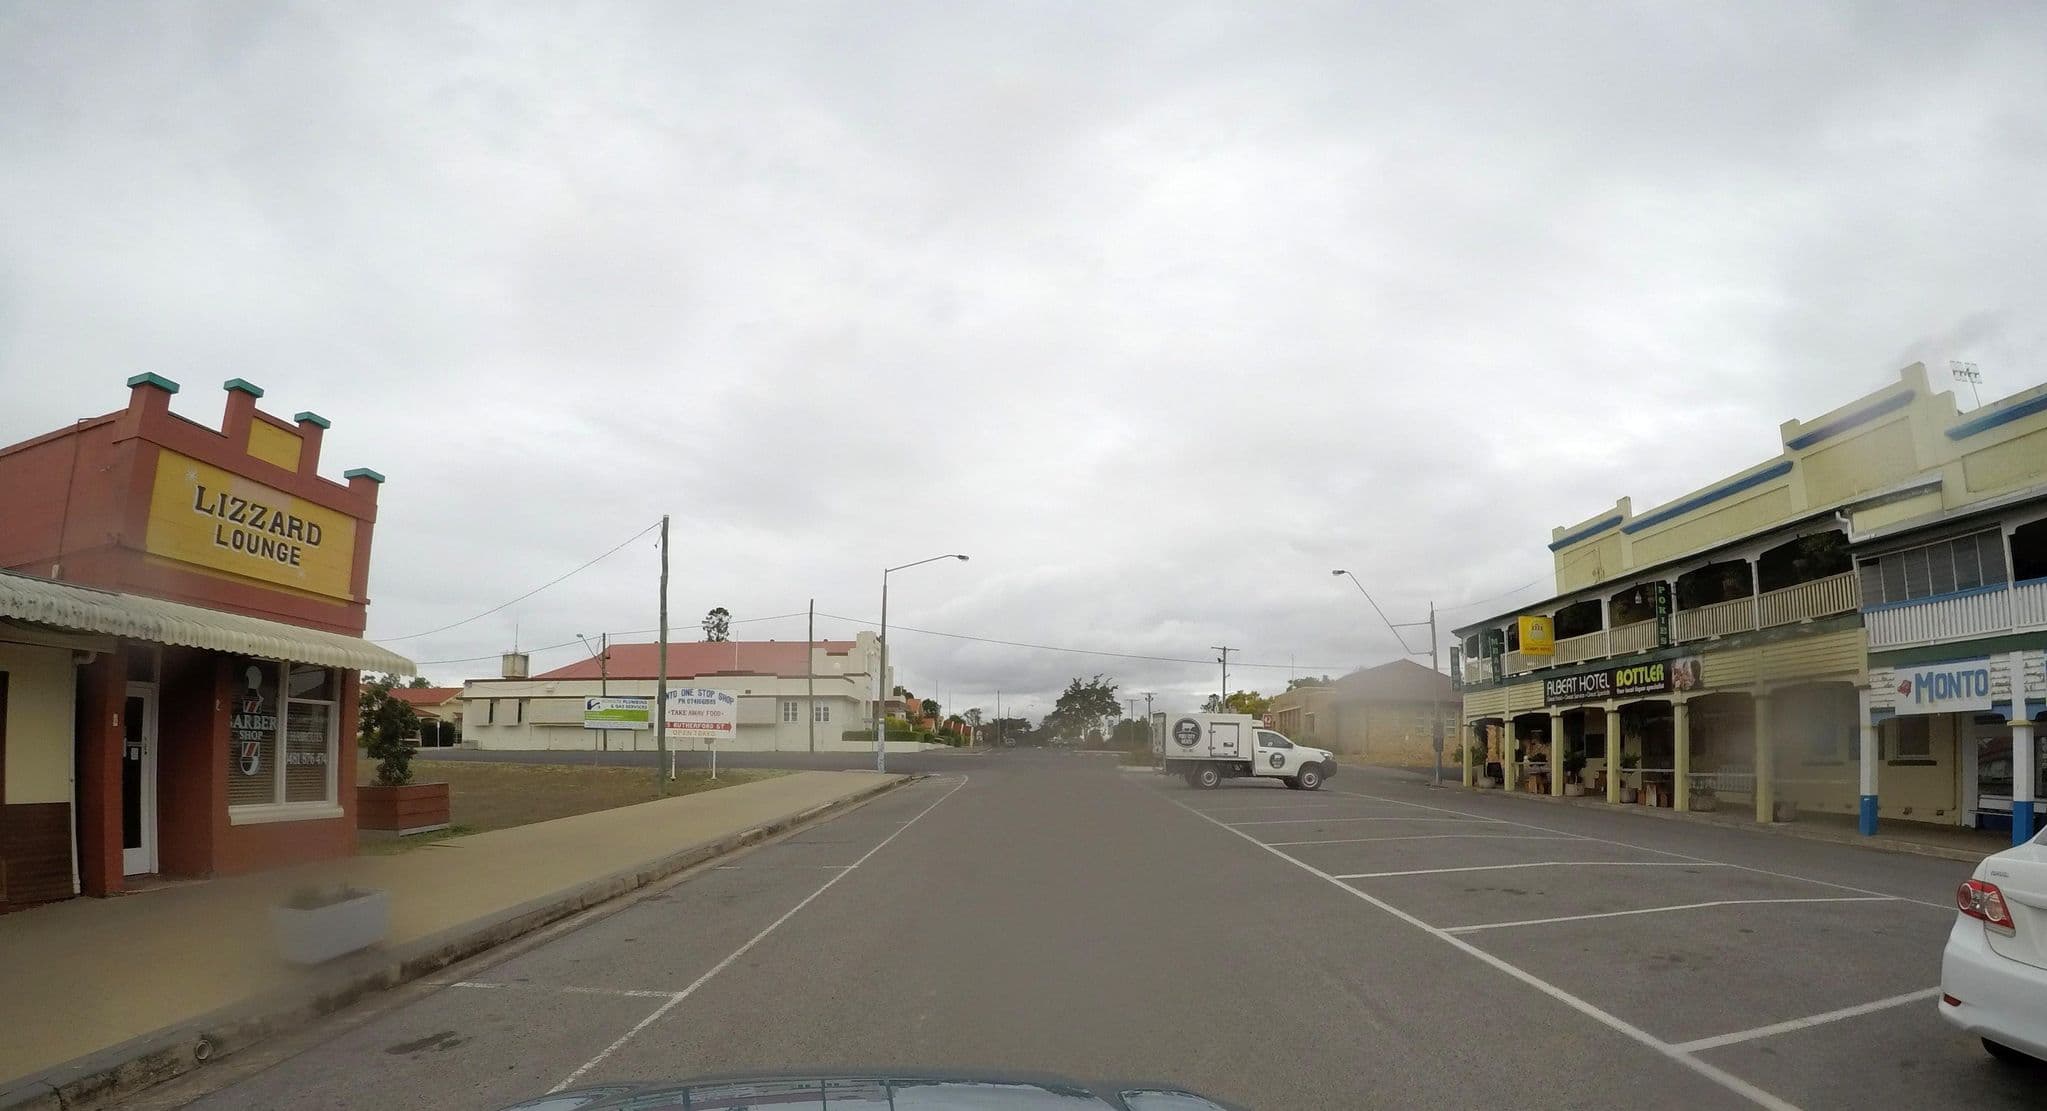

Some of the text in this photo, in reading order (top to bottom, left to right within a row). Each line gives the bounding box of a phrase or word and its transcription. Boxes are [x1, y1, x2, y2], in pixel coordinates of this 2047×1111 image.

[194, 485, 322, 547] LIZZARD
[215, 524, 302, 567] LOUNGE
[1658, 586, 1668, 645] POKIES
[1547, 672, 1610, 696] ALBERT HOTEL
[1616, 664, 1664, 687] BOTTLER
[1915, 669, 1988, 704] MONTO
[698, 689, 715, 698] STOP
[719, 692, 734, 704] SHOP
[230, 715, 279, 730] ARBER
[240, 731, 264, 741] SHOP
